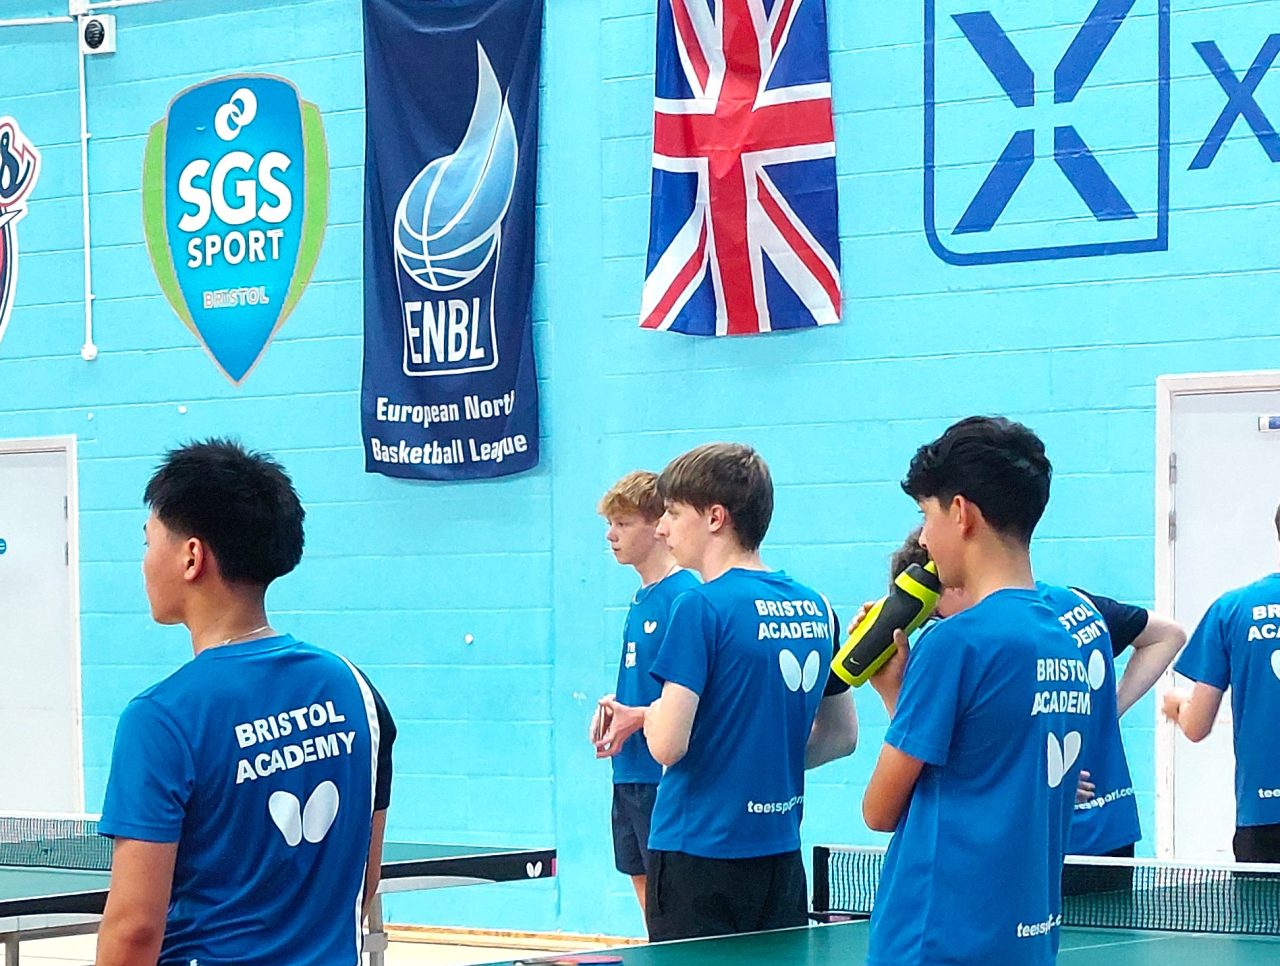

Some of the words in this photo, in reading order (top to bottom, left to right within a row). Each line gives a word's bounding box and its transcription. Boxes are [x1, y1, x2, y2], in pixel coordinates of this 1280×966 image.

[177, 150, 293, 232] SGS
[187, 228, 284, 268] SPORT
[203, 286, 270, 309] BRISTOL
[404, 297, 485, 364] ENBL
[376, 396, 460, 428] European
[370, 437, 464, 464] Basketball
[755, 599, 823, 617] BRISTOL
[1058, 603, 1094, 631] STOL
[758, 621, 829, 640] ACADEMY
[1031, 691, 1091, 716] ACADEM
[235, 700, 345, 749] BRISTOL
[235, 731, 357, 784] ACADEMY
